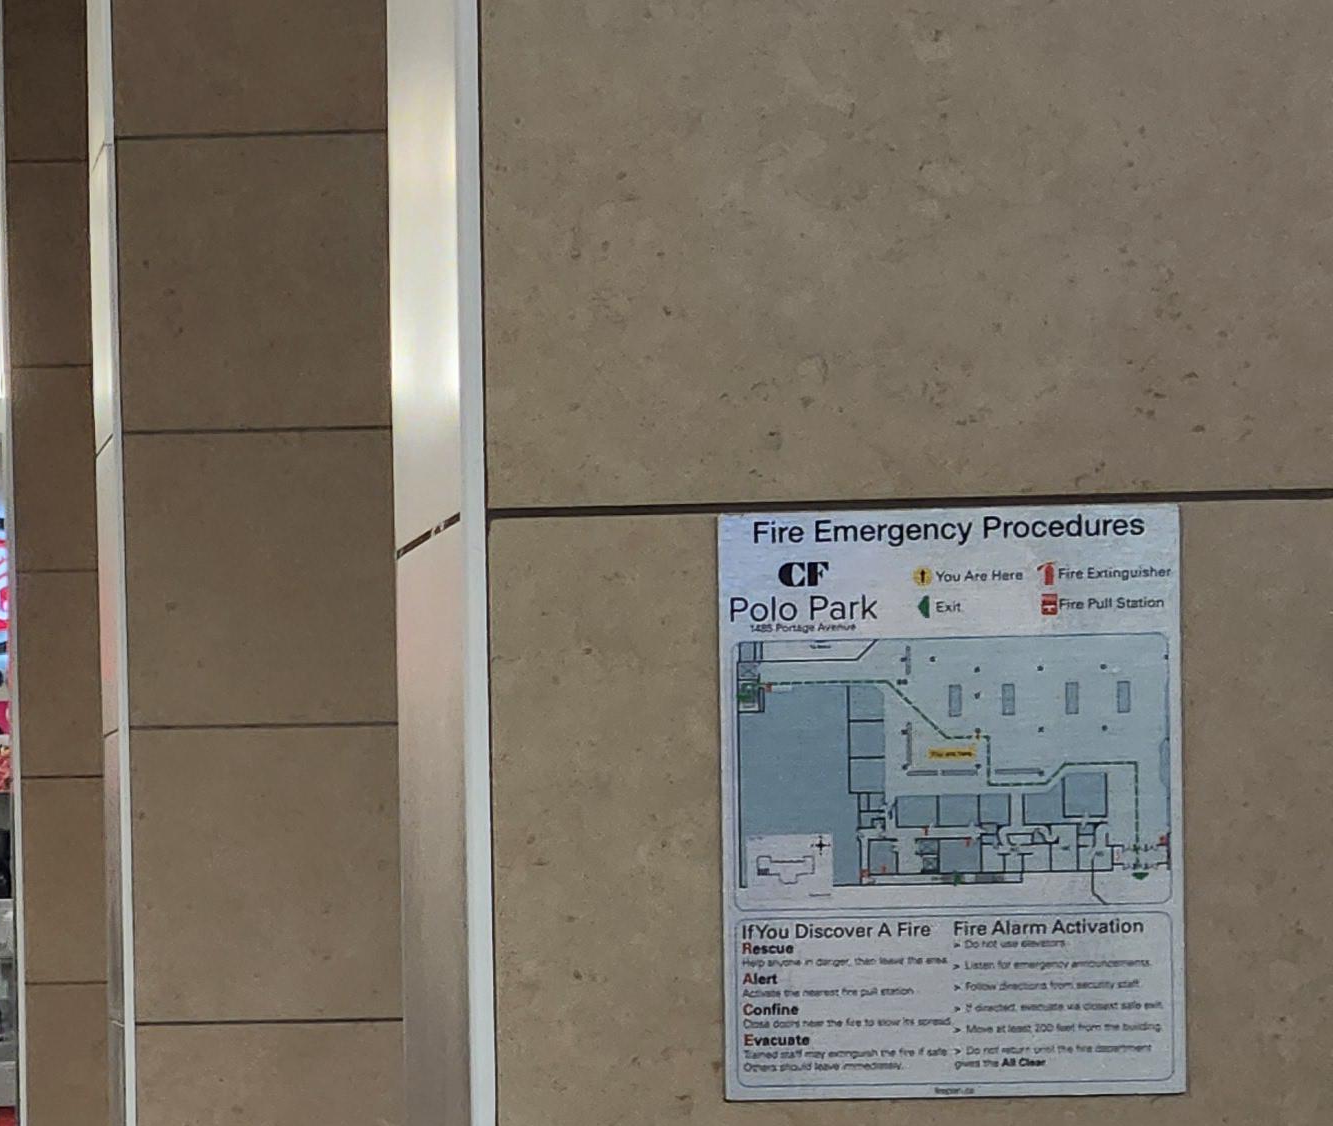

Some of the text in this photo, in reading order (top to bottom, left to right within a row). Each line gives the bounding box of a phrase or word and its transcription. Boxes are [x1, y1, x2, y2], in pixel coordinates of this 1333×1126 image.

[753, 514, 1145, 547] Fire Emergency Procedures
[778, 562, 829, 587] CF
[936, 570, 1023, 583] You Are Here
[1058, 566, 1171, 581] Fire Extinguisher
[730, 595, 877, 622] Polo Park
[936, 602, 961, 613] Exit
[1059, 597, 1164, 610] Fire Pull Station
[776, 624, 815, 634] Portage
[818, 623, 856, 632] Avenue
[742, 922, 931, 939] If You Discover A Fire
[954, 918, 1144, 936] Fire Alarm Activation
[742, 943, 794, 955] Rescue
[742, 972, 778, 985] Alert
[743, 1003, 799, 1016] Confine
[744, 1034, 810, 1047] Evacuate
[1001, 1058, 1016, 1067] All
